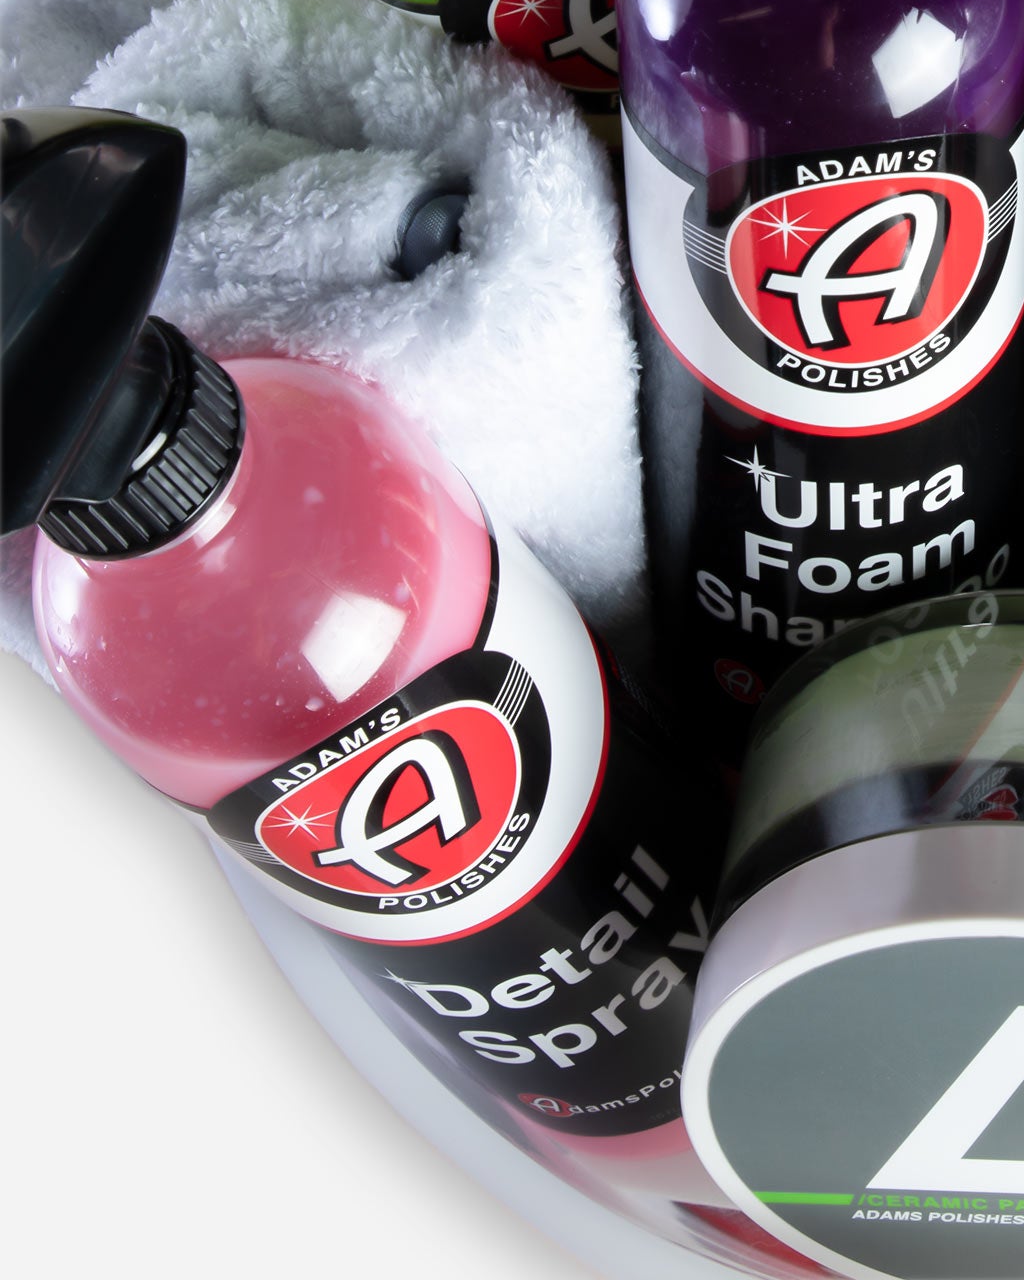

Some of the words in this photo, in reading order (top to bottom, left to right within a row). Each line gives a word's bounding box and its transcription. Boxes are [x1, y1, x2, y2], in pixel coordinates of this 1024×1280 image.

[796, 148, 937, 186] ADAM'S
[776, 332, 951, 389] POLISHES
[758, 463, 965, 531] Ultra
[744, 518, 976, 594] Foam
[271, 707, 401, 792] ADAM'S
[378, 811, 530, 910] POLISHES
[411, 844, 670, 1018] Detail
[458, 894, 710, 1069] Spray
[852, 1209, 922, 1221] ADAMS
